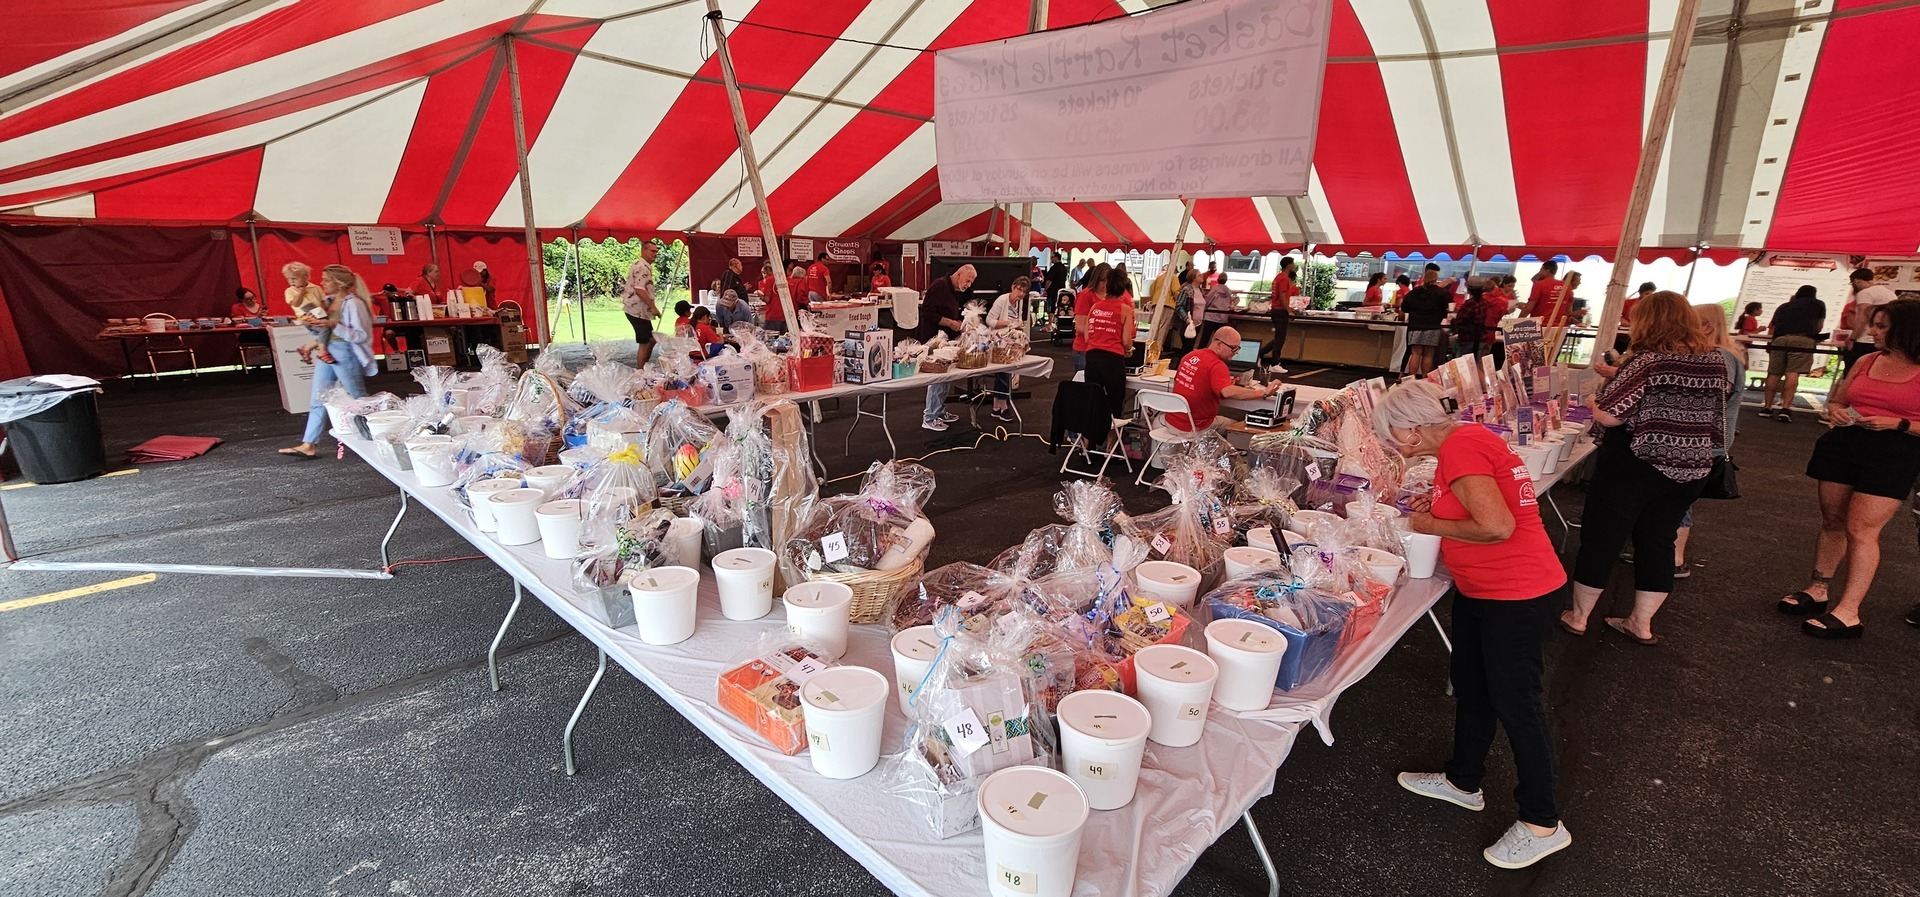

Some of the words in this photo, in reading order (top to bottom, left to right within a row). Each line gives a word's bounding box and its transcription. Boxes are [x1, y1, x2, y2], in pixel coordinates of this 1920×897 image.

[833, 247, 856, 255] Shops
[848, 313, 859, 321] Fried
[859, 313, 872, 321] Dough
[1216, 521, 1226, 529] 55
[828, 541, 840, 552] 45
[1150, 607, 1163, 618] 50
[801, 664, 816, 674] 47
[902, 683, 913, 694] 46
[1188, 707, 1200, 716] 50
[956, 722, 974, 739] 48
[1089, 765, 1103, 776] 49
[1004, 871, 1021, 886] 48
